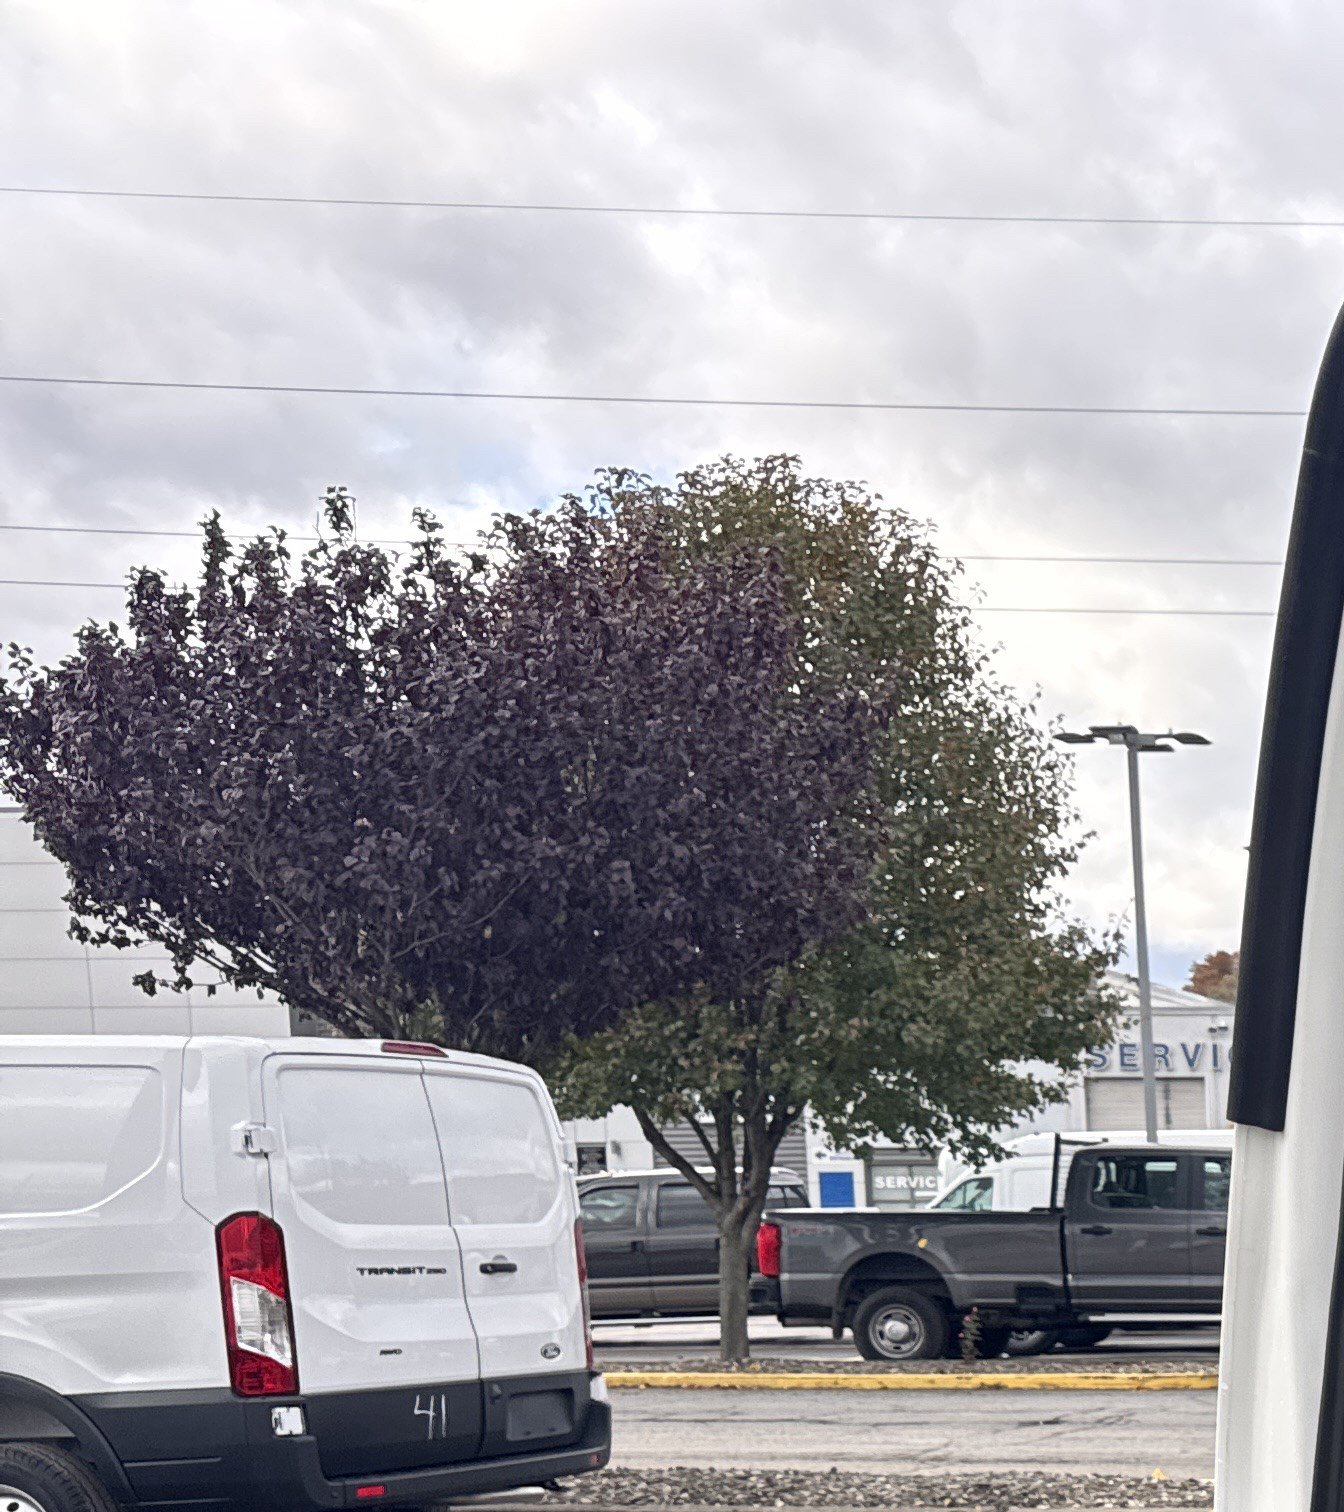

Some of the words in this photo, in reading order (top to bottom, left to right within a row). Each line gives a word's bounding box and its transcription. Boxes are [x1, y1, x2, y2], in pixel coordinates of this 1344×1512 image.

[1089, 1043, 1233, 1070] SERVI
[874, 1176, 938, 1189] SERVIC
[356, 1266, 425, 1276] TRANSIT
[414, 1394, 447, 1440] 41
